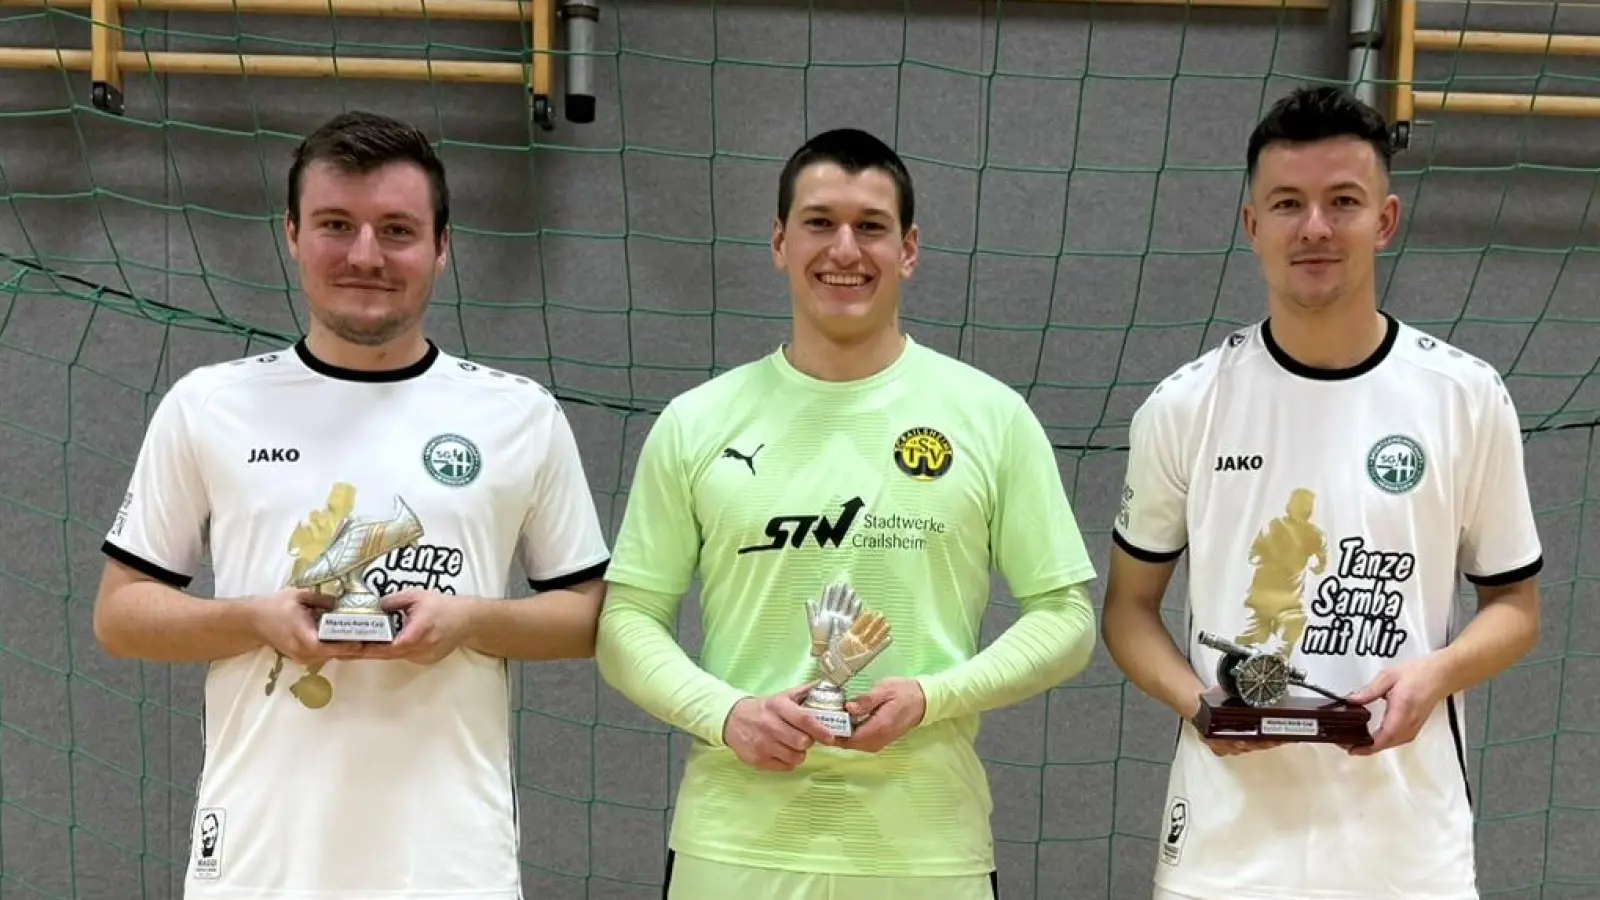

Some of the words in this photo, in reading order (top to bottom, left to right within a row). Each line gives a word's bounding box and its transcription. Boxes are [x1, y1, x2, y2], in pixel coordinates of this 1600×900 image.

[248, 448, 301, 463] JAKO
[1214, 455, 1264, 471] JAKO
[863, 513, 946, 534] Stadtwerke
[851, 533, 927, 550] Crailsheim
[1338, 536, 1416, 582] Tanze
[1311, 576, 1404, 619] Samba
[1302, 616, 1354, 656] mit
[1355, 615, 1408, 658] Mir
